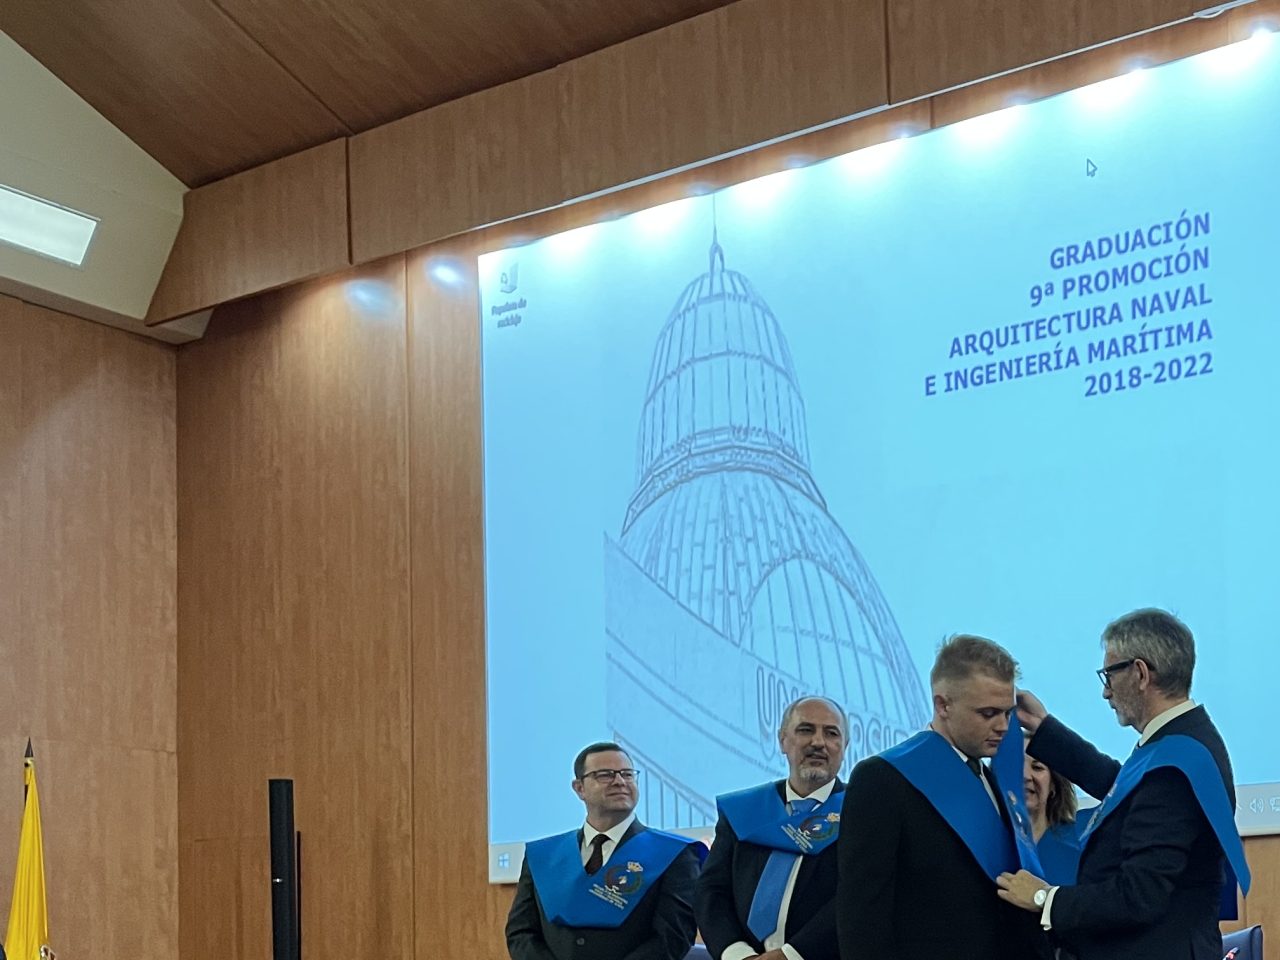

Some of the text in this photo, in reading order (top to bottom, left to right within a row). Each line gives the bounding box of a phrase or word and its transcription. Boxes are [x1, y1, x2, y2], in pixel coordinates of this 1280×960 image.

[1050, 209, 1211, 270] GRADUACIÓN
[1030, 243, 1210, 307] 9ª PROMOCIÓN
[949, 283, 1213, 359] ARQUITECTURA NAVAL
[924, 318, 1213, 396] E INGENIERÍA MARÍTIMA
[1084, 352, 1214, 397] 2018-2022
